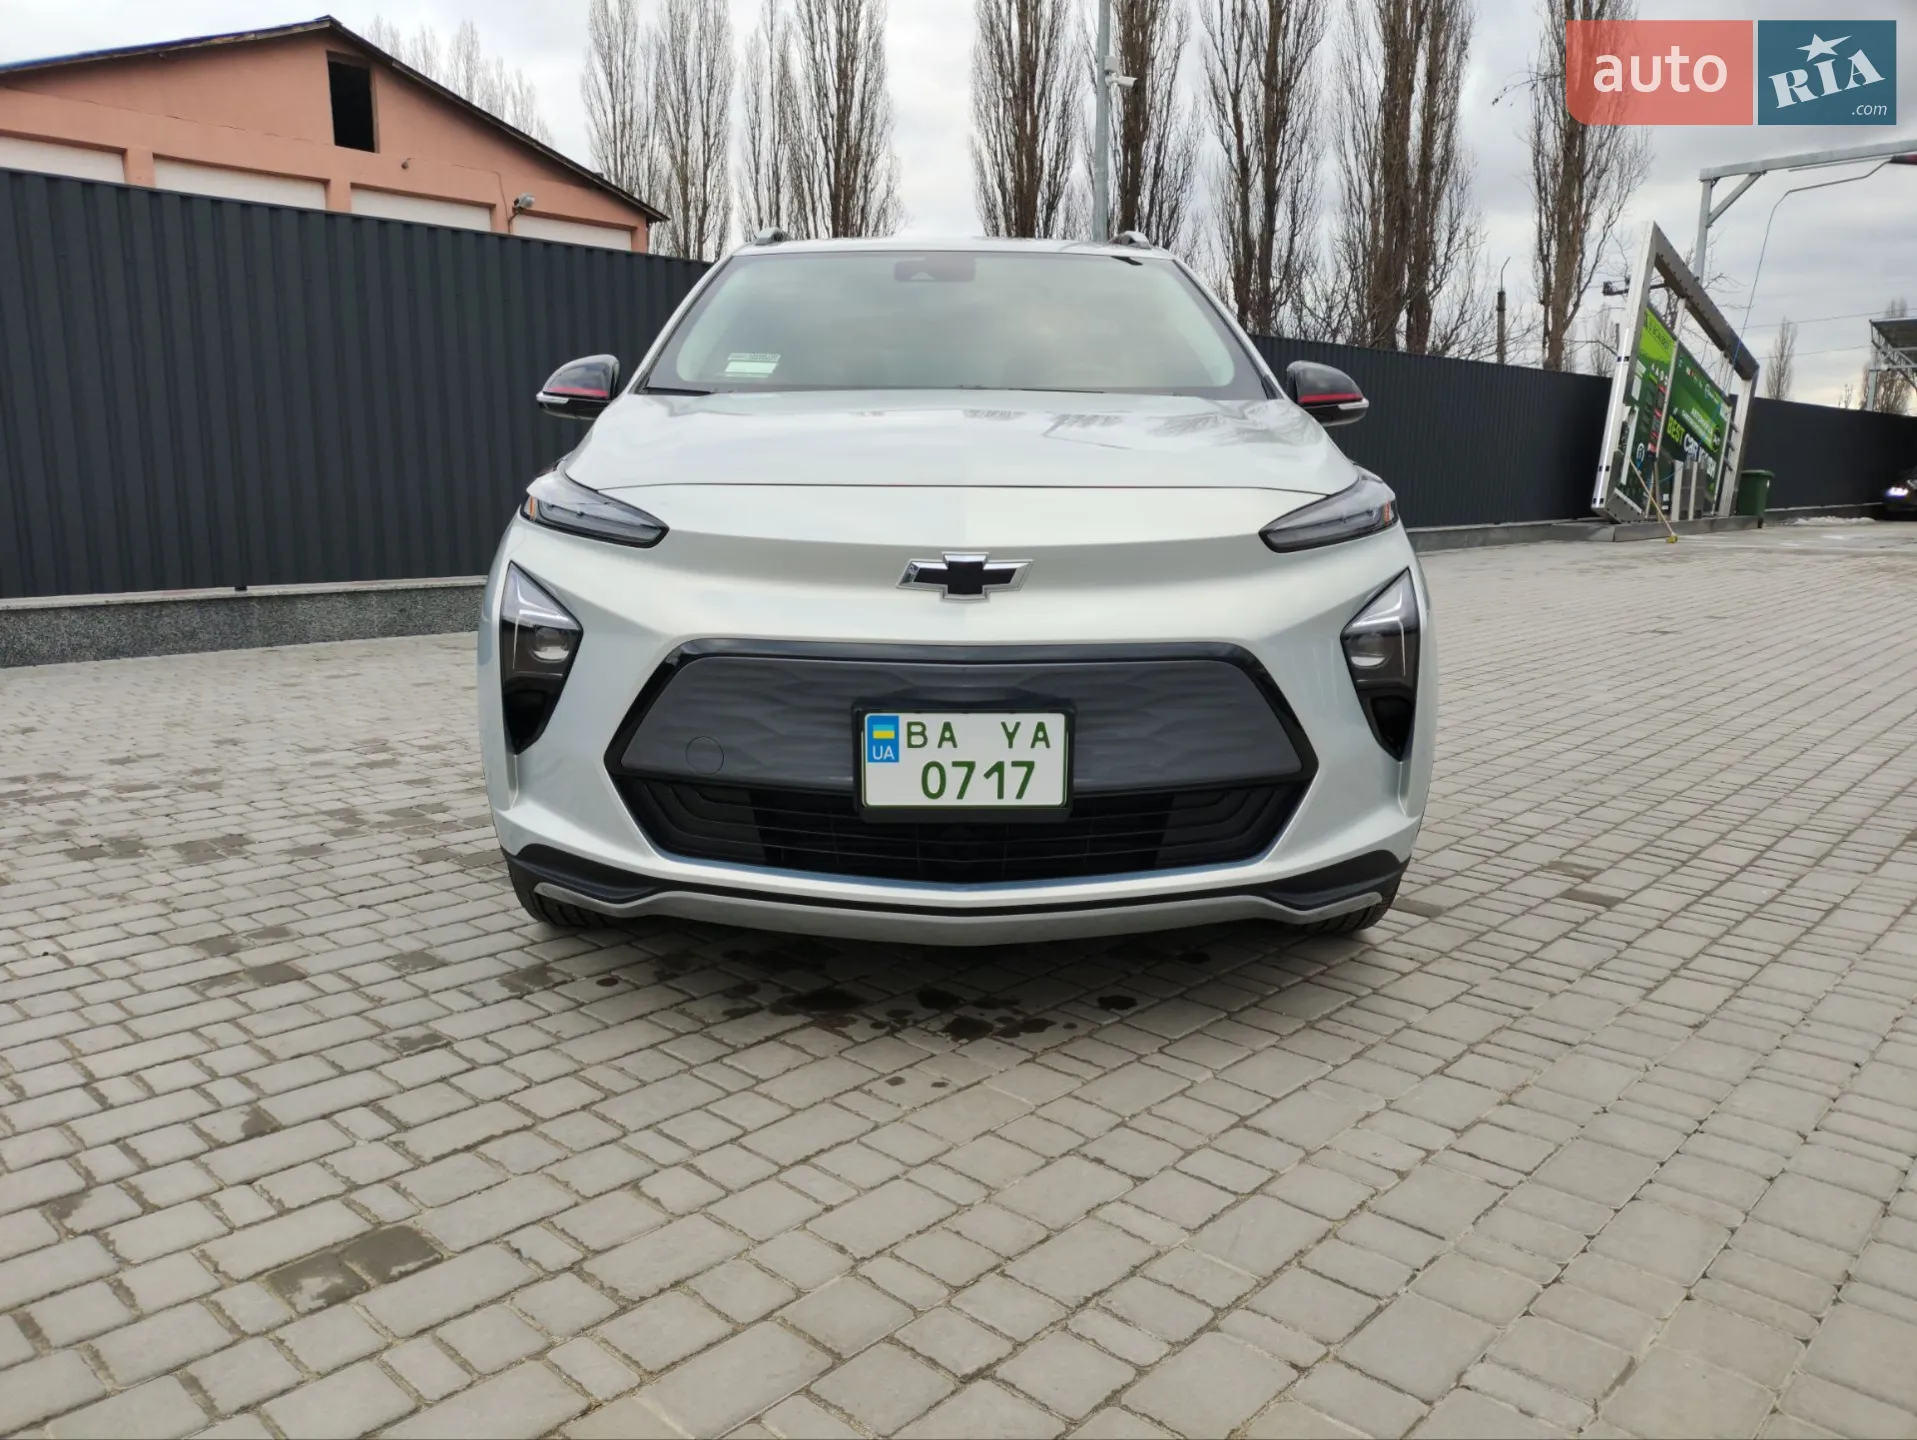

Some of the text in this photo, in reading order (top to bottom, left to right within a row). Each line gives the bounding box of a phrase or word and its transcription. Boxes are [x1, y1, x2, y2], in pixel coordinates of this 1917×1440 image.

[1667, 415, 1685, 445] BEST
[906, 721, 1051, 749] BA YA
[872, 745, 895, 760] UA
[921, 760, 1036, 800] 0717
